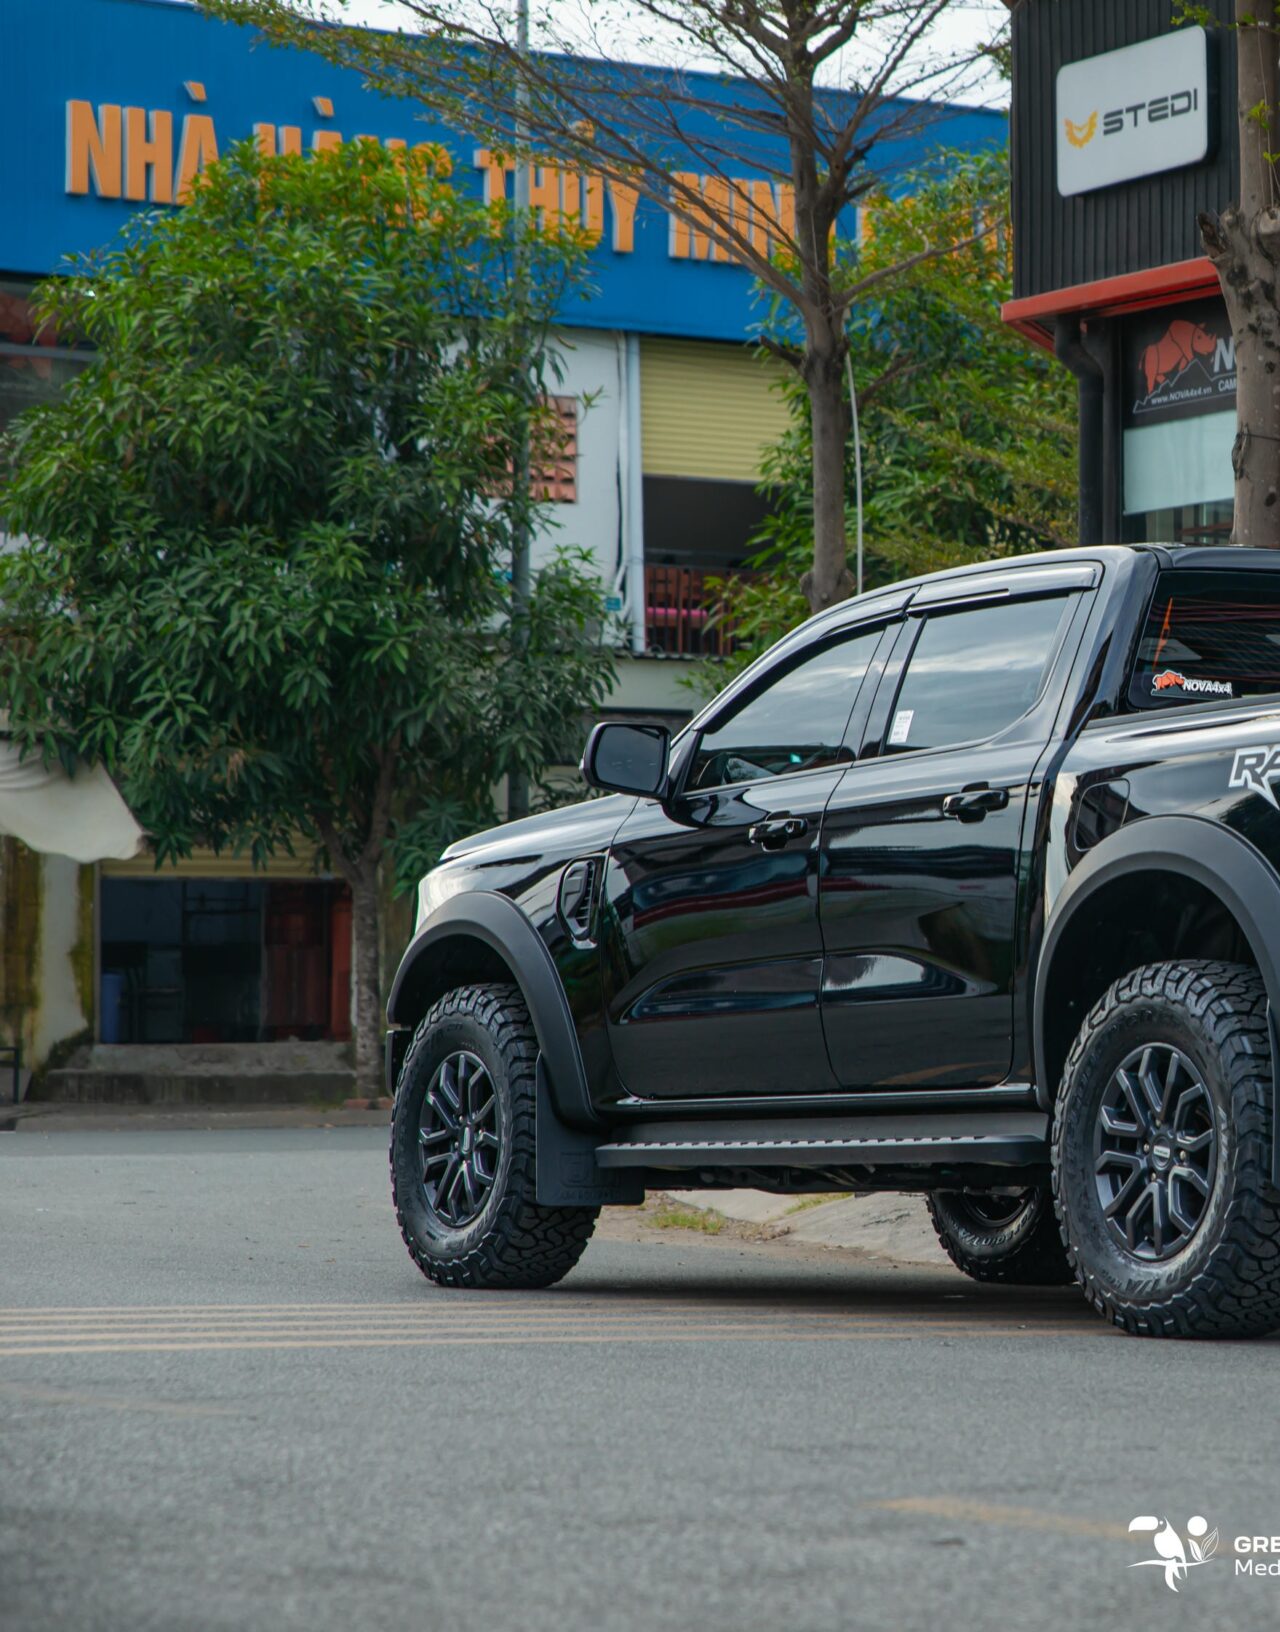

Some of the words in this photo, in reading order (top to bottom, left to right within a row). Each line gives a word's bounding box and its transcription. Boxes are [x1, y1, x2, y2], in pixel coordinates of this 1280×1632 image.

[1102, 88, 1198, 136] STEDI
[65, 80, 219, 205] NHÀ
[668, 171, 837, 272] MIN
[1150, 385, 1212, 405] www.NOVA4x4.vn
[1182, 678, 1232, 695] NOVA4x4
